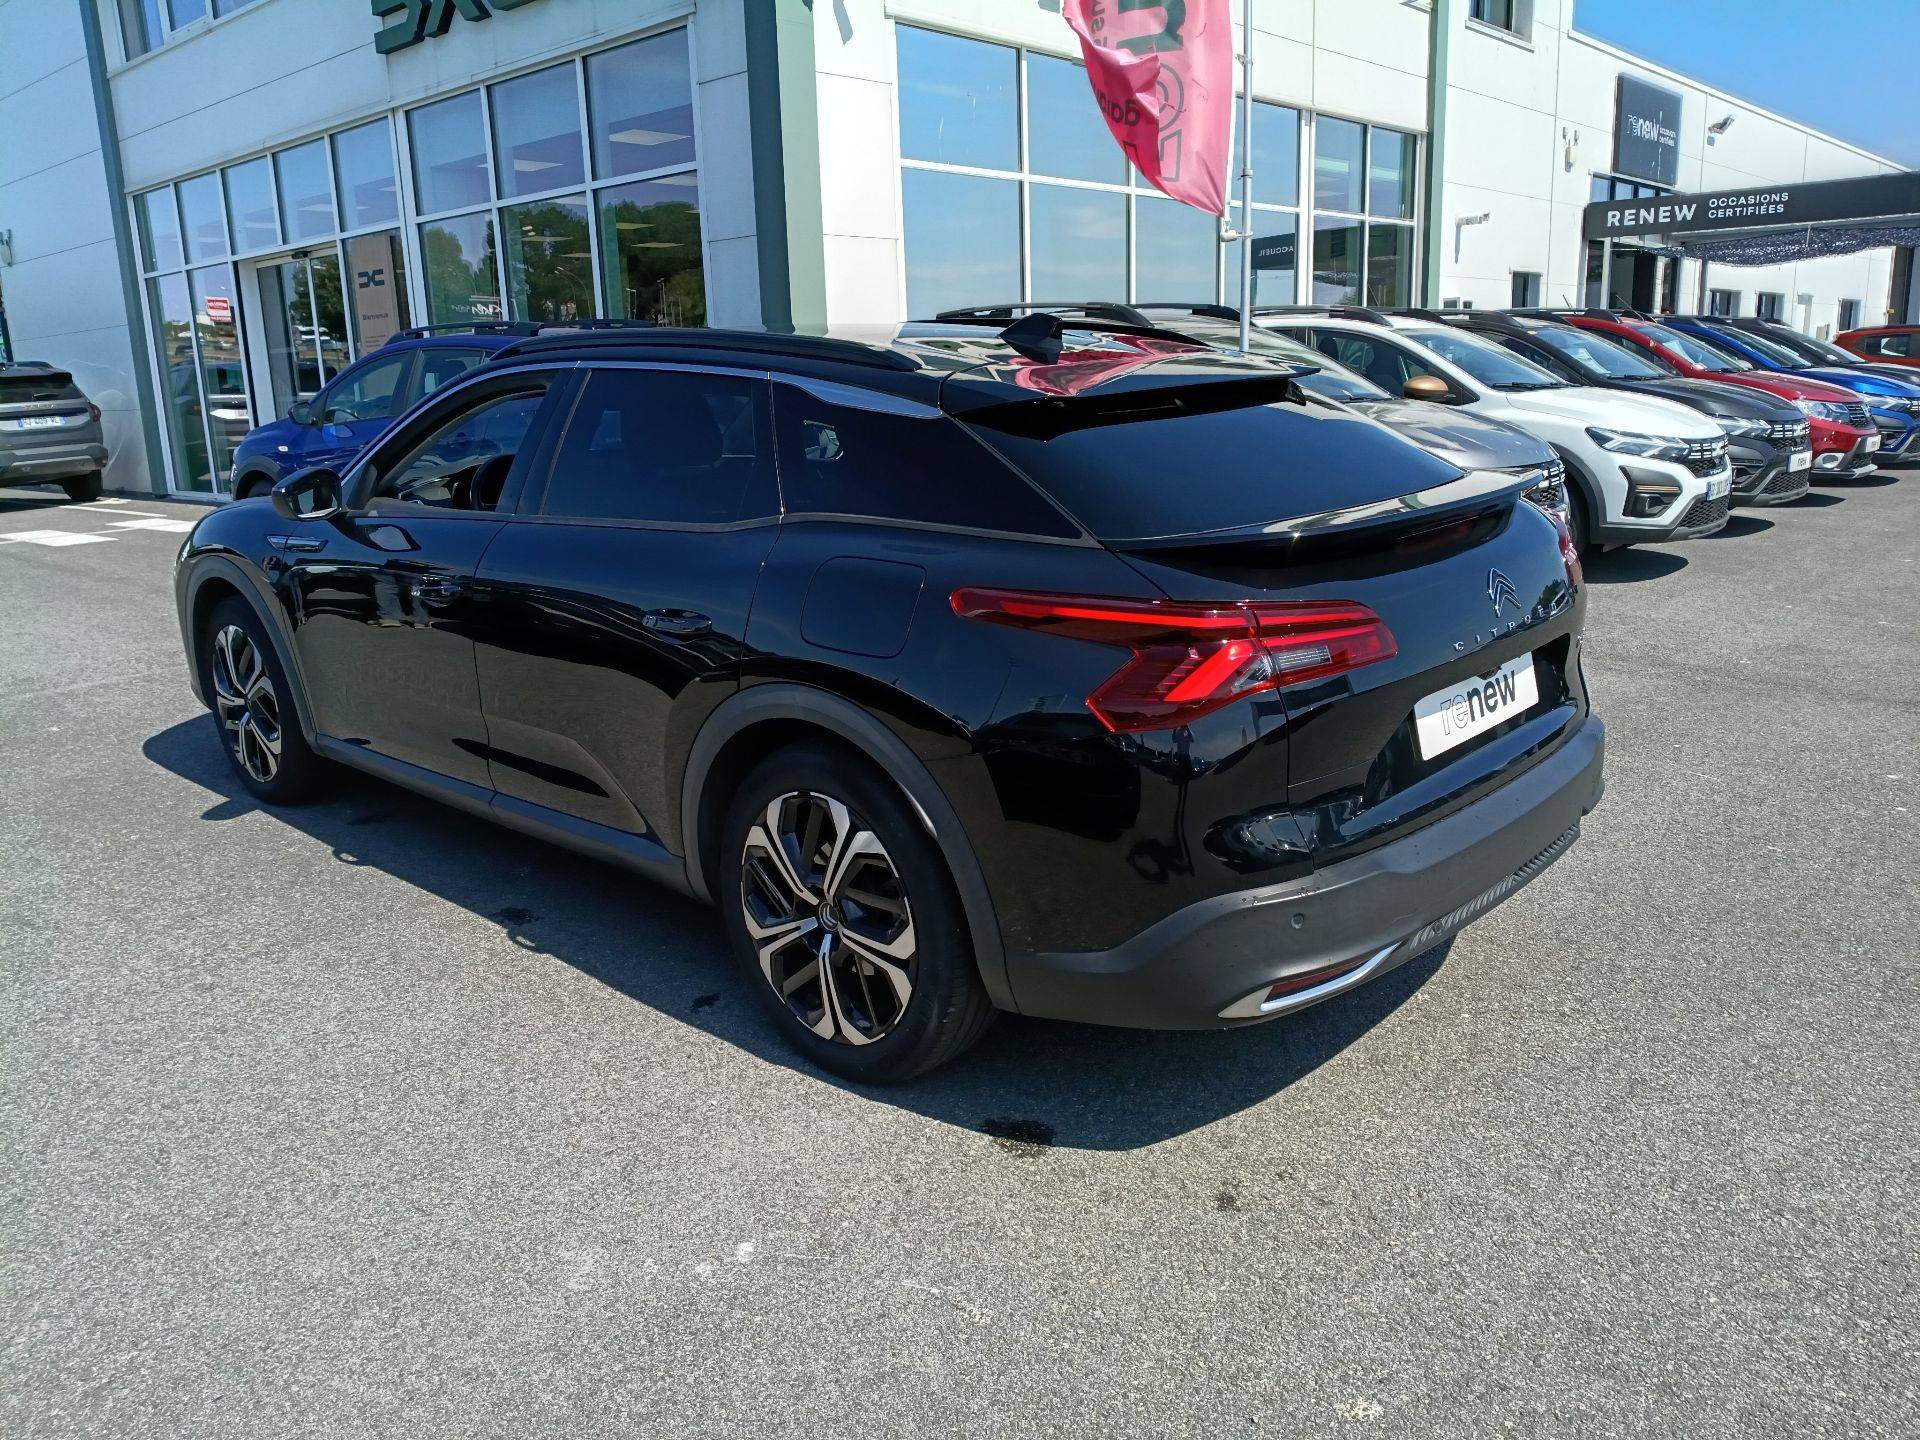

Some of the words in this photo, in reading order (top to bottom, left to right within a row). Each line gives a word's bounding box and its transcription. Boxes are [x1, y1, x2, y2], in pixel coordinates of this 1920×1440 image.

[1709, 192, 1789, 208] OCCASIONS
[1607, 203, 1697, 227] RENEW
[1708, 203, 1785, 218] CERTIFIÉES
[1440, 670, 1516, 736] renew
